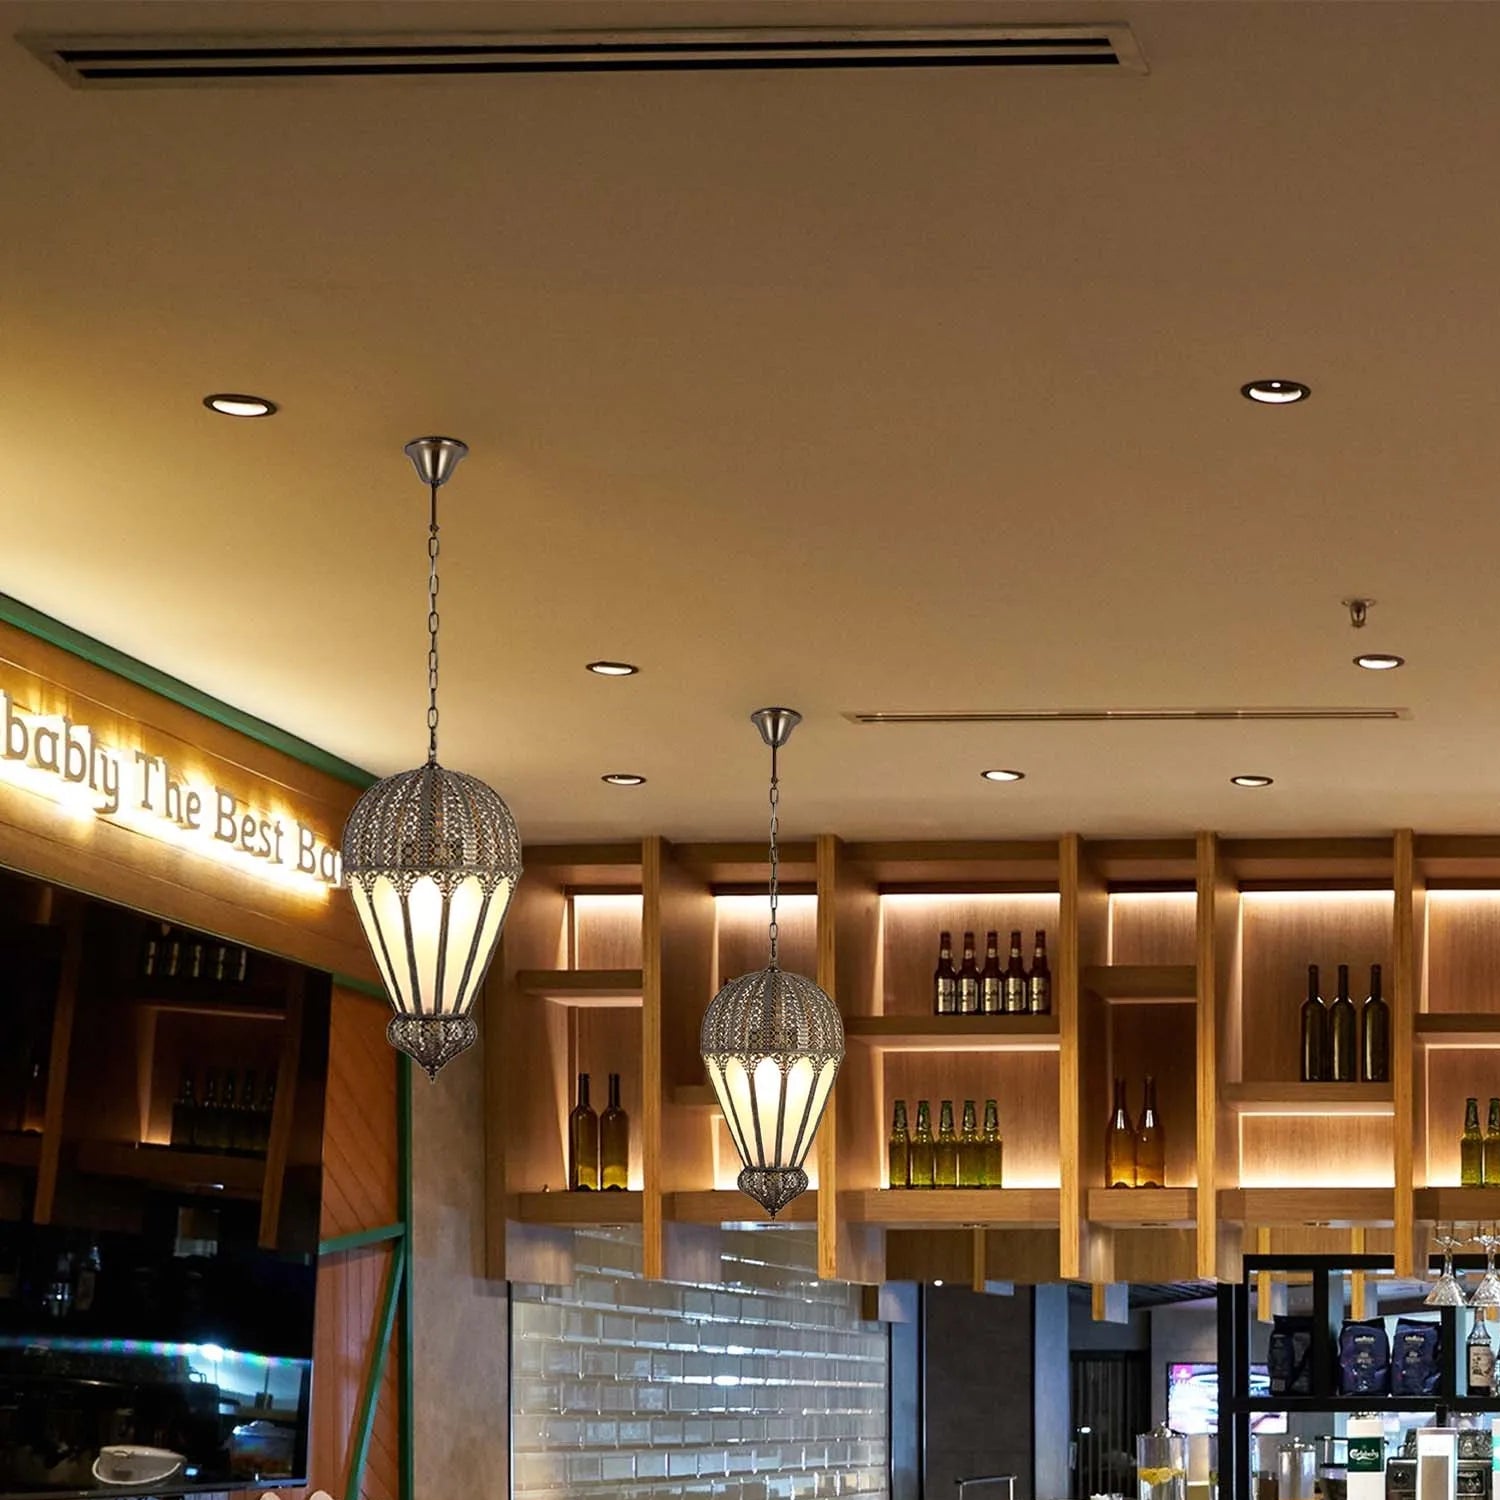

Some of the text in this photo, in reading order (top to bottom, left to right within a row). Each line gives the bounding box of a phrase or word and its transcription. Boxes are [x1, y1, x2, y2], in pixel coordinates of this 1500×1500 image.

[2, 690, 119, 814] bably
[134, 750, 201, 830] The
[214, 784, 284, 864] Best
